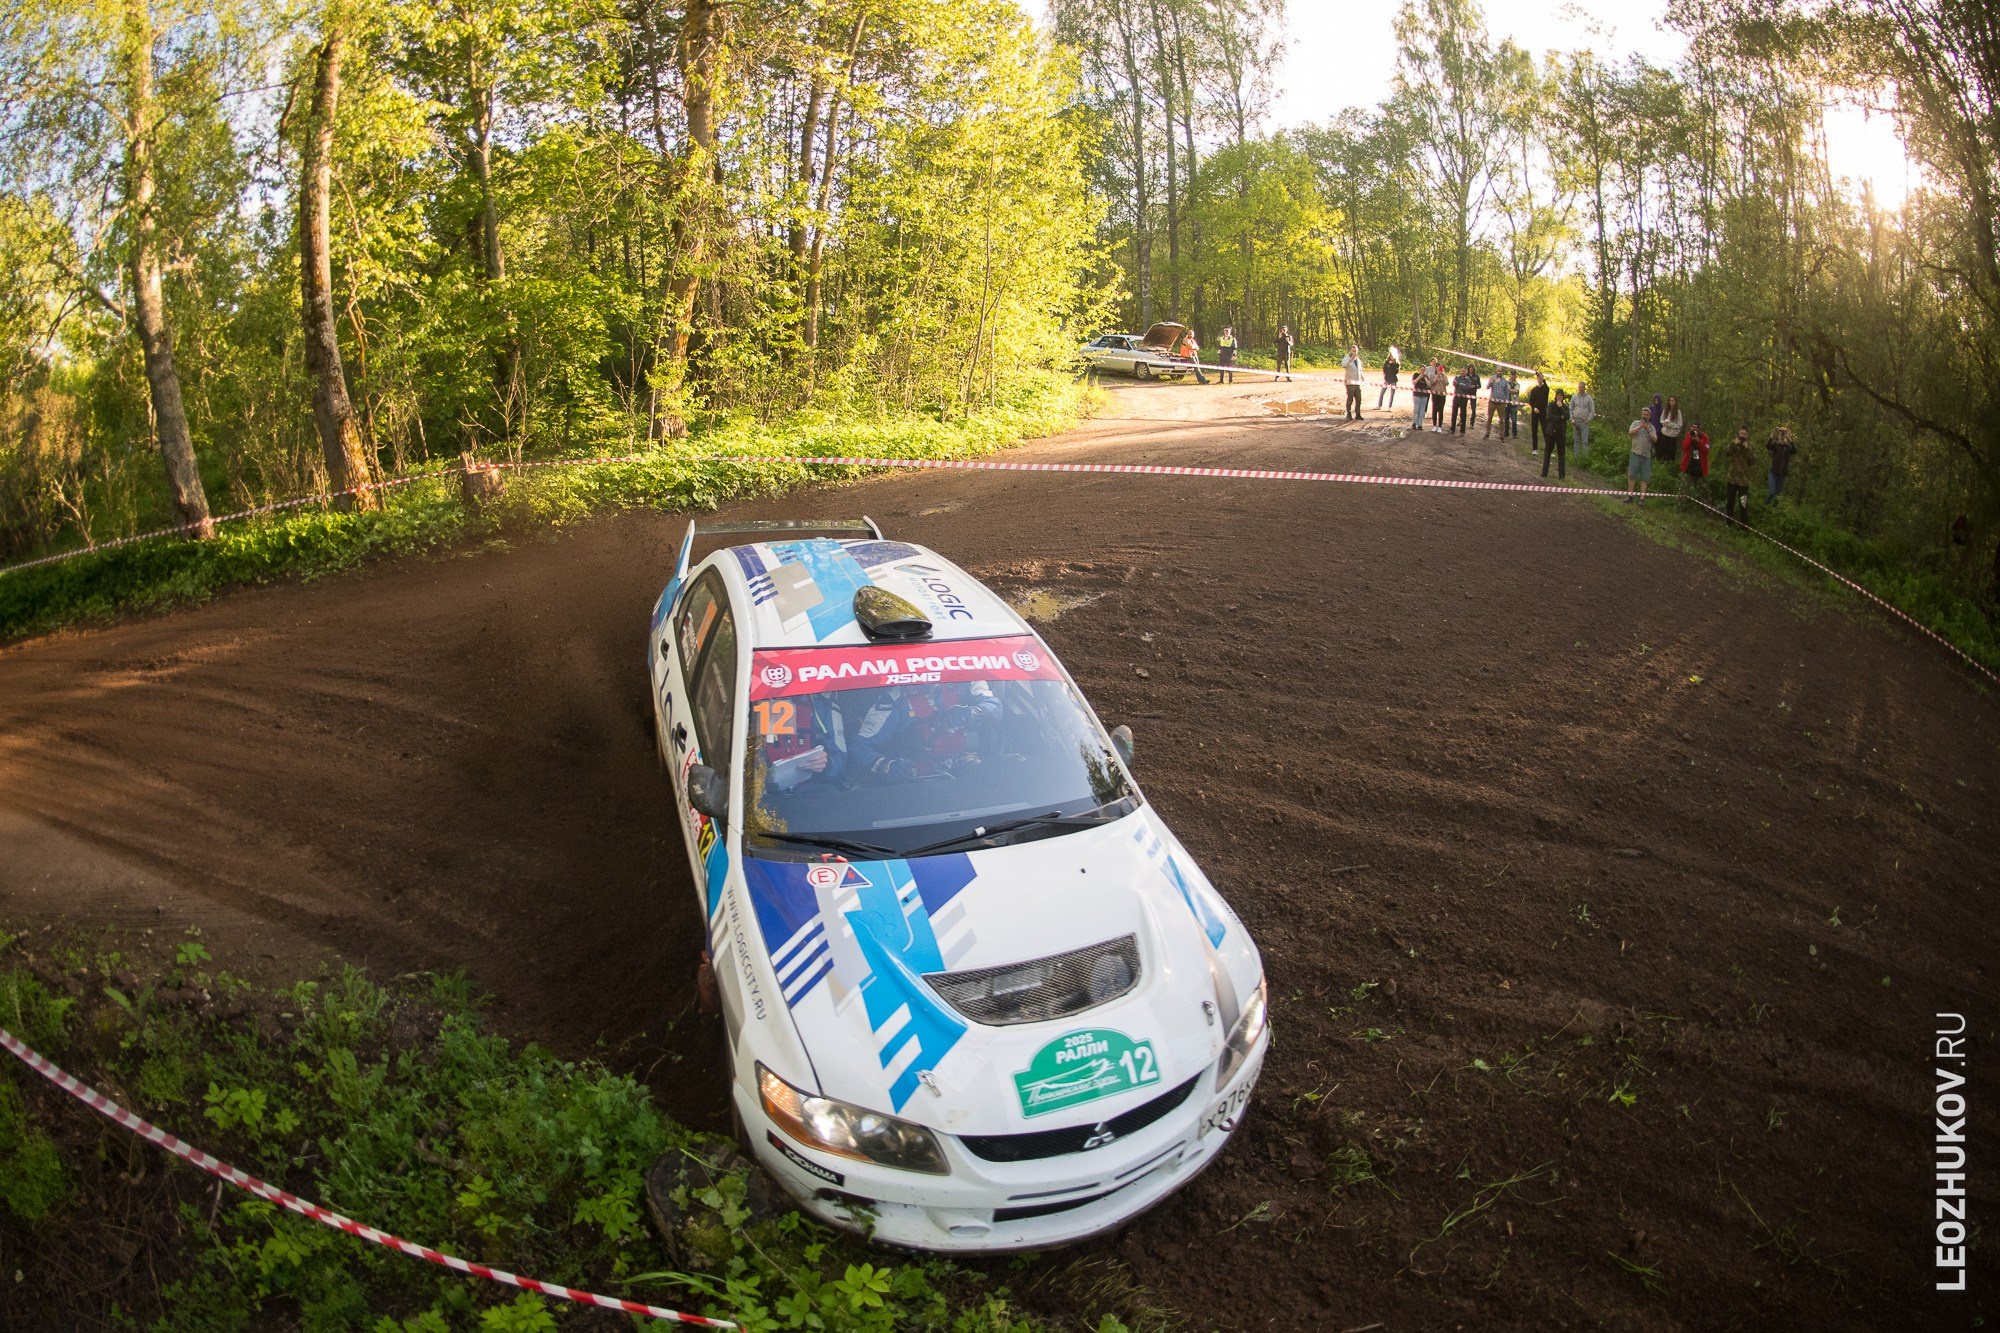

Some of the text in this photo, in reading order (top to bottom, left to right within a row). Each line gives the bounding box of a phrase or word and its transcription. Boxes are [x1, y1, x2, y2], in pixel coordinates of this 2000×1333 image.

[921, 577, 974, 620] LOGIC
[797, 655, 1011, 682] РАЛЛИ РОССИИ
[753, 701, 795, 735] 12
[726, 884, 767, 1021] WWW.LOGICCITY.RU
[1055, 1040, 1109, 1065] РАЛЛИ
[1063, 1032, 1094, 1048] 2025
[1118, 1046, 1159, 1085] 12
